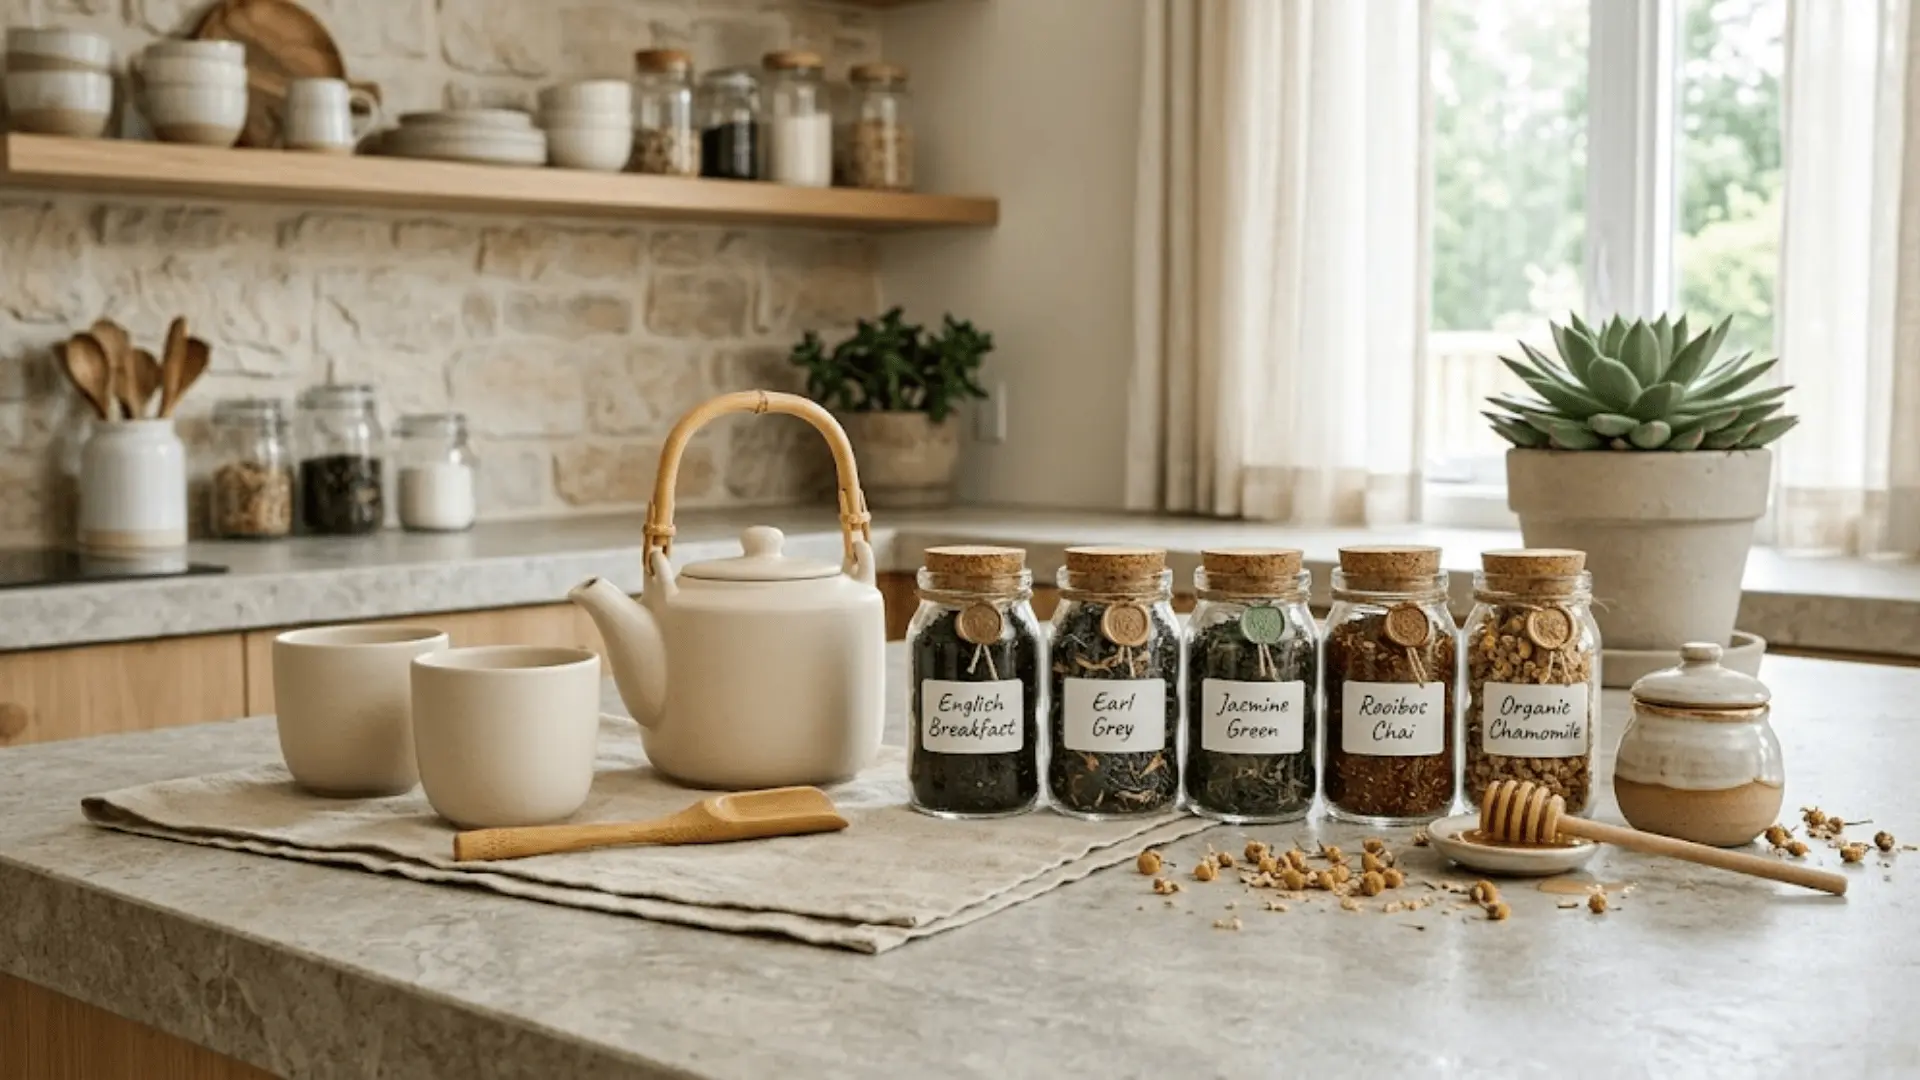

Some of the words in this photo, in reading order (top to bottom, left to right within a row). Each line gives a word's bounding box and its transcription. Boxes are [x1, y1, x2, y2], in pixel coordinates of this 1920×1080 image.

[1093, 692, 1136, 712] Earl
[1500, 695, 1571, 720] Organic
[1092, 716, 1135, 742] Grey
[1227, 718, 1278, 739] Green
[1372, 720, 1416, 741] Chai
[1489, 718, 1581, 740] Chamomile
